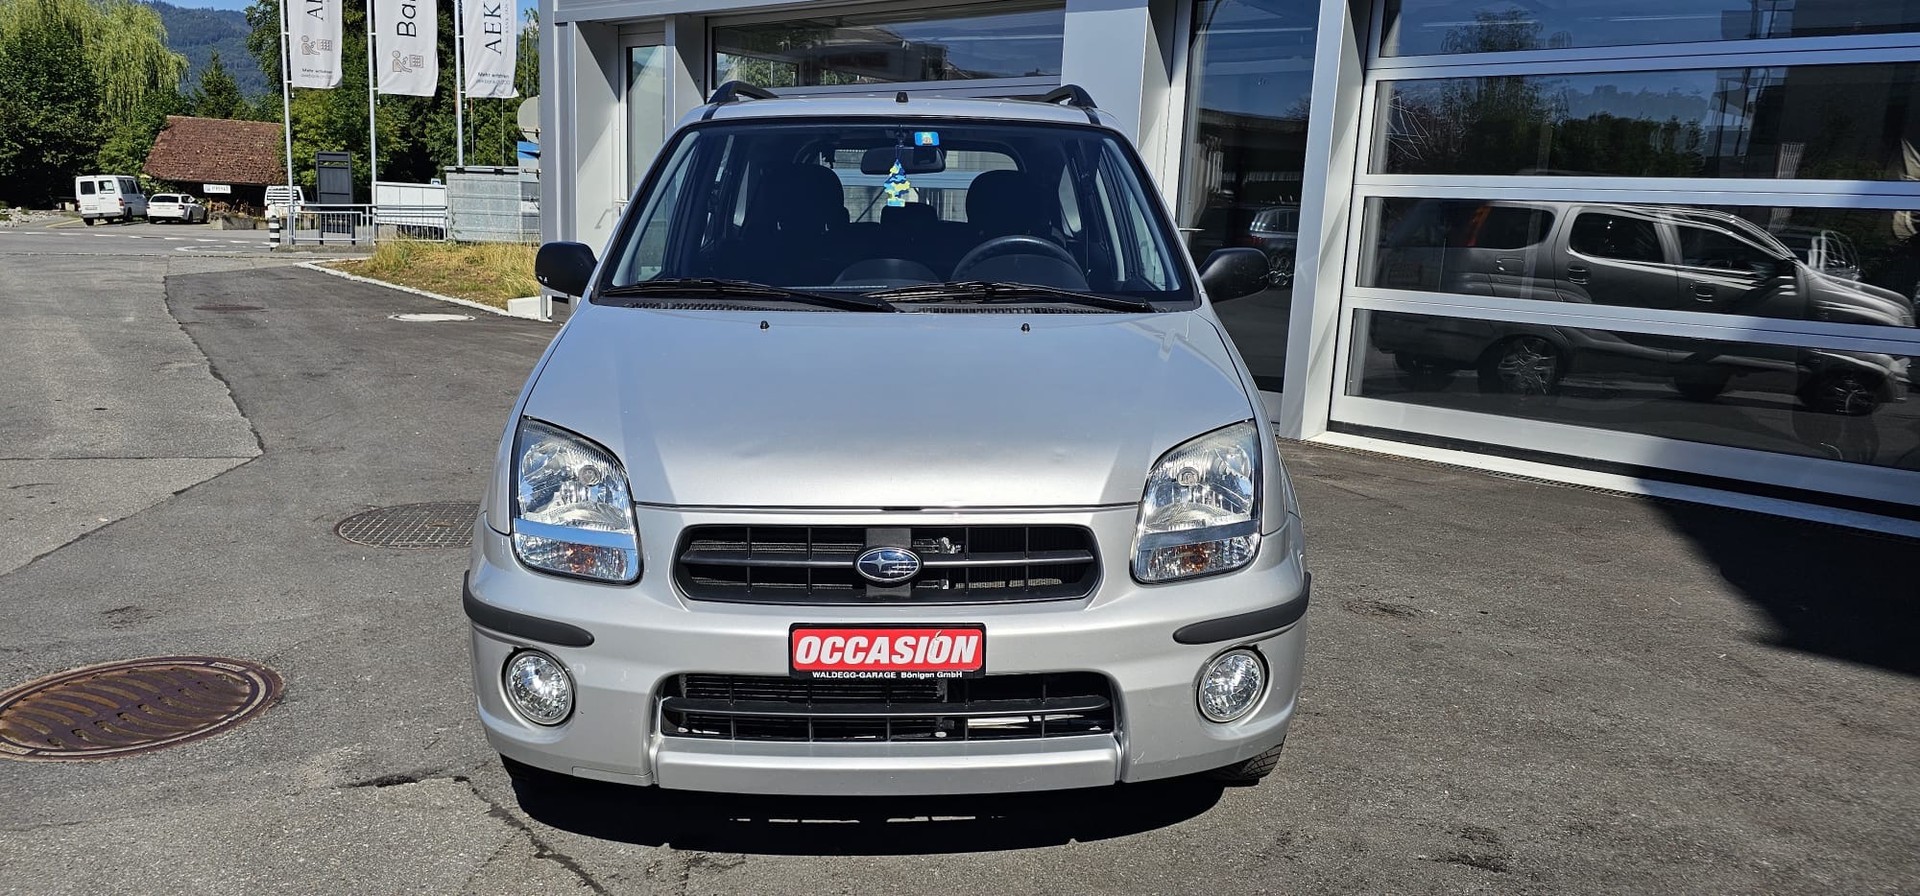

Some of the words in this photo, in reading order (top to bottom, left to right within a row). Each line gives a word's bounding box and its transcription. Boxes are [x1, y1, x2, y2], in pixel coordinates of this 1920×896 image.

[306, 0, 324, 21] A
[396, 0, 416, 37] Ba
[483, 2, 502, 56] AEK
[795, 635, 979, 665] OCCASION
[812, 671, 897, 679] WALDEGG-GARAGE
[900, 670, 935, 680] Bönigen
[936, 671, 963, 679] GmbH
